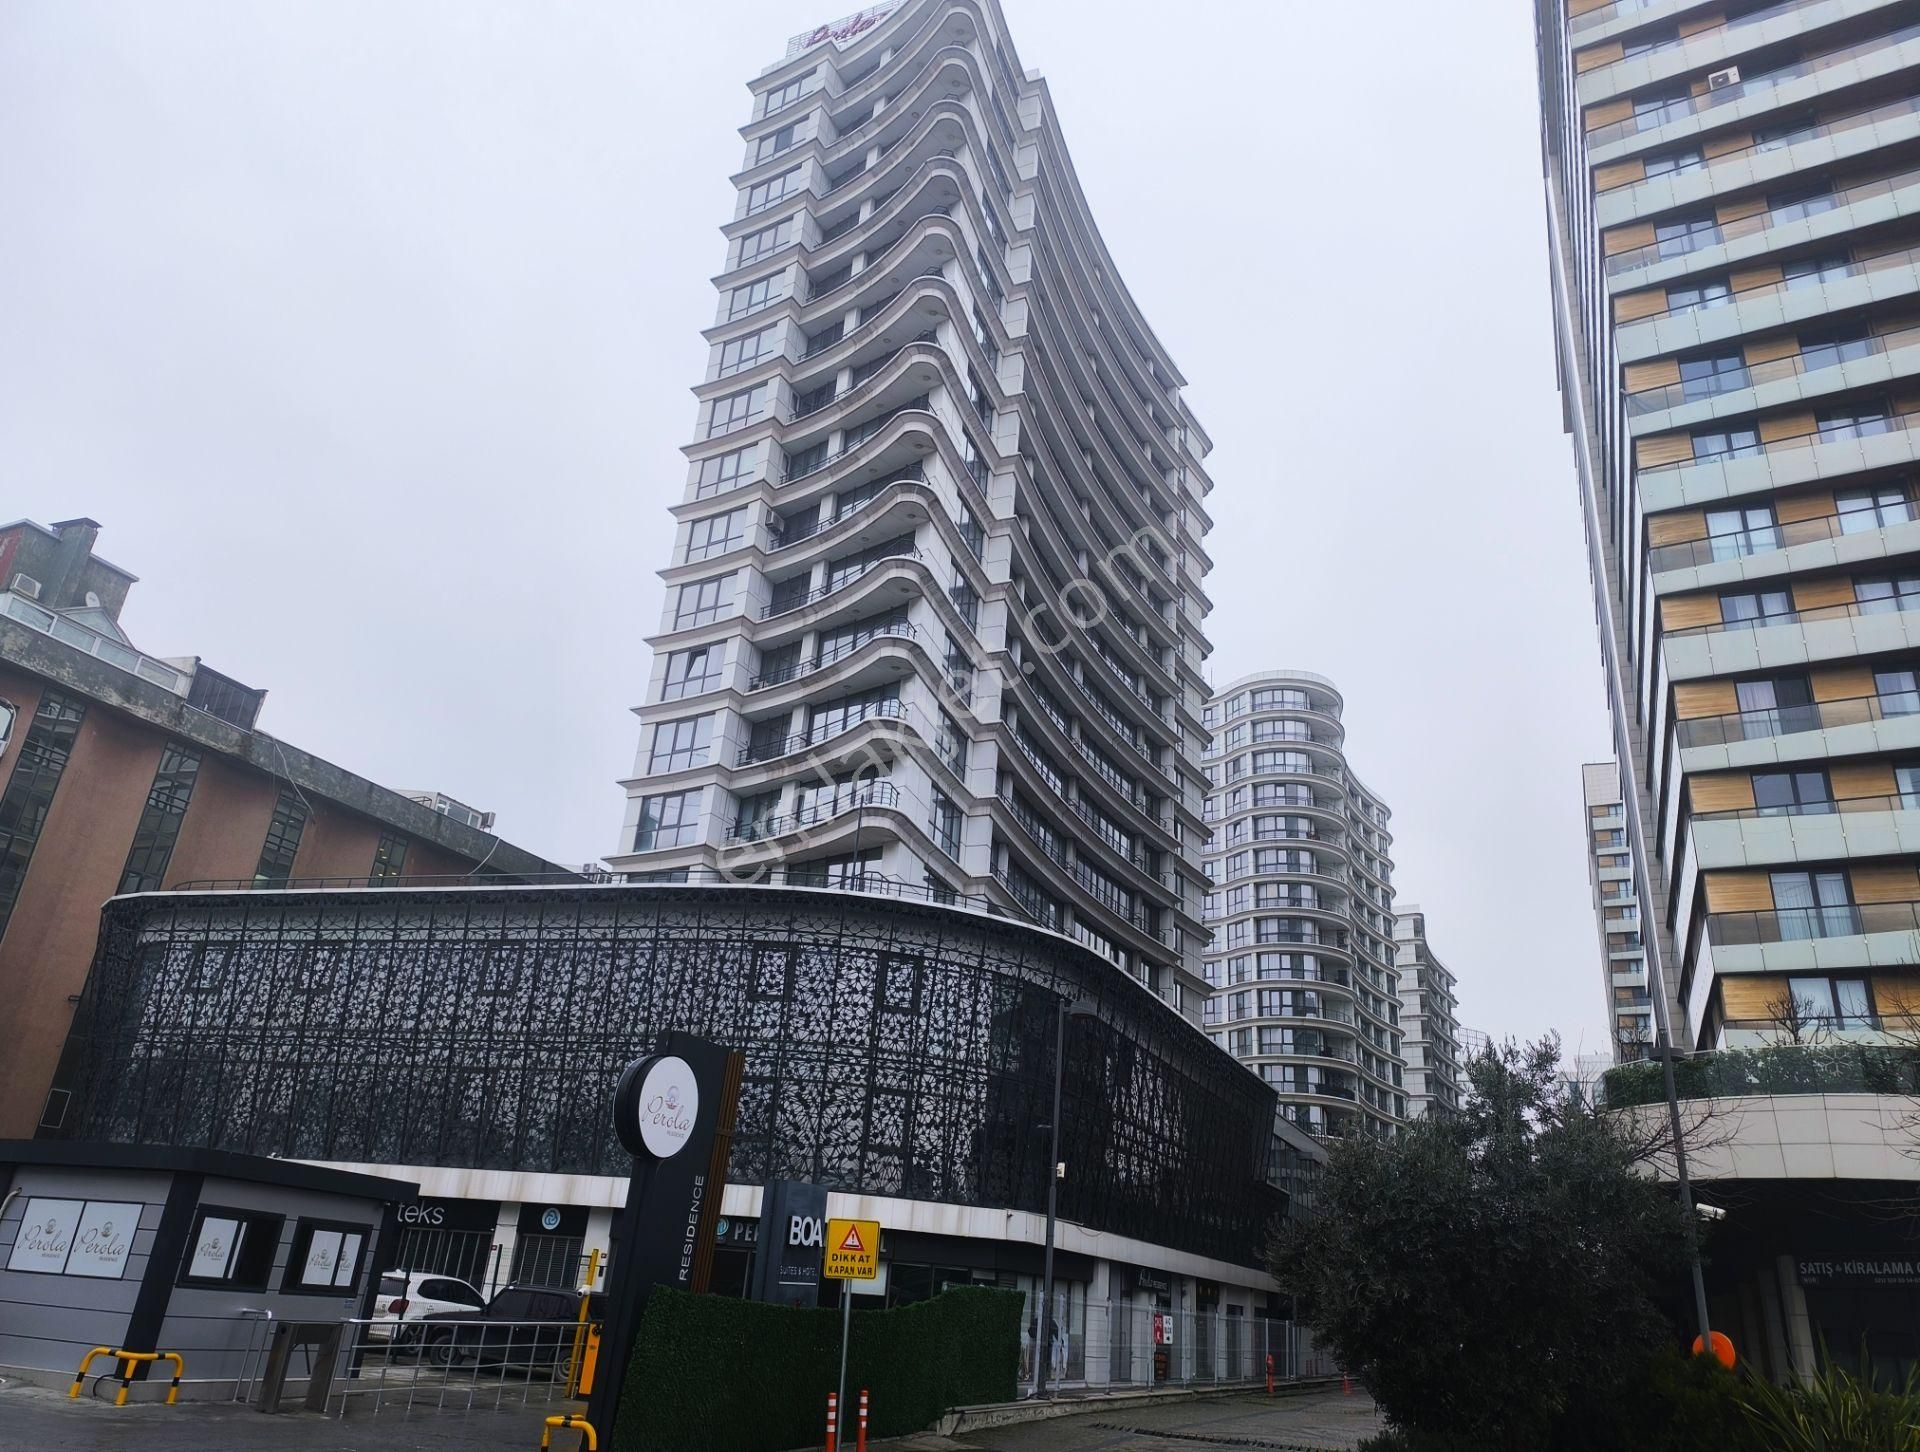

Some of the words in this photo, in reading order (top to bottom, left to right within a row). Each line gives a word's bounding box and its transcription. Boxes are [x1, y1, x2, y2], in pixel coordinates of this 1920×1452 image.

[641, 1096, 690, 1131] Perola
[17, 1225, 68, 1252] Perola
[74, 1228, 126, 1256] Perola
[679, 1175, 705, 1281] RESIDENCE
[789, 1215, 823, 1247] BOA
[828, 1265, 855, 1275] KAPAN
[857, 1266, 873, 1276] VAR
[1800, 1261, 1833, 1277] SATIŞ
[1843, 1259, 1914, 1275] KİRALAMA
